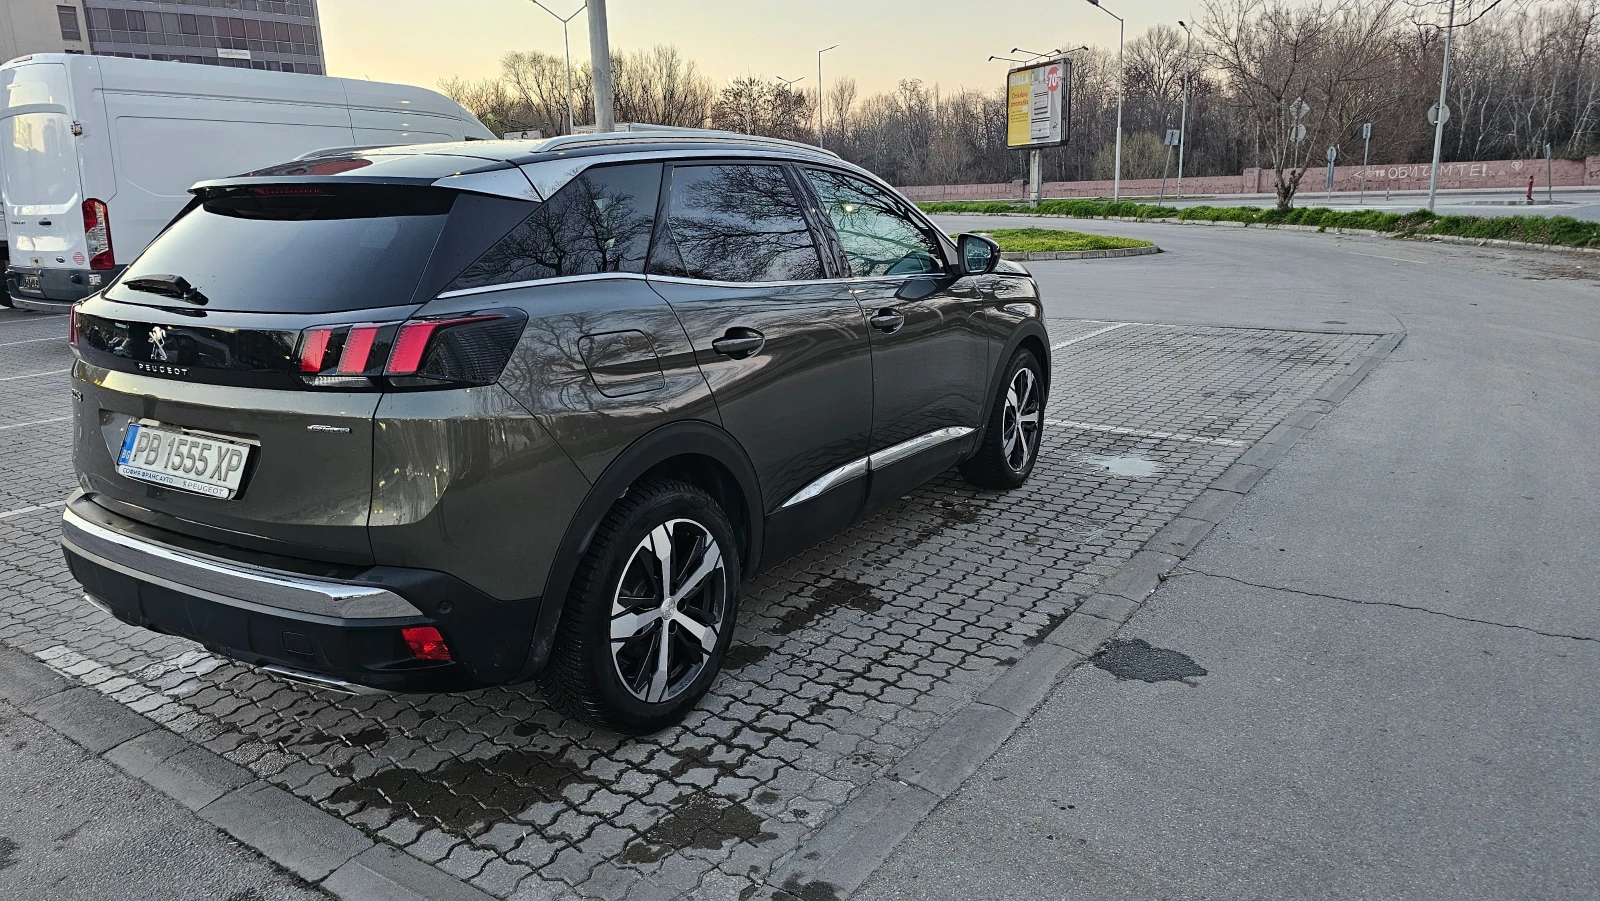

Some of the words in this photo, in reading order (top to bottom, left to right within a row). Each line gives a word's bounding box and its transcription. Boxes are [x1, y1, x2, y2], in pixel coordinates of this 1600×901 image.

[138, 363, 188, 376] PEUGEOT
[121, 449, 131, 459] BG
[132, 431, 162, 465] PB
[164, 437, 212, 476] 1555
[209, 446, 243, 482] XP
[122, 467, 142, 477] СОФИЯ
[141, 472, 159, 481] ФРАНС
[159, 475, 174, 484] АУТО
[187, 482, 224, 495] PEUGEOT
